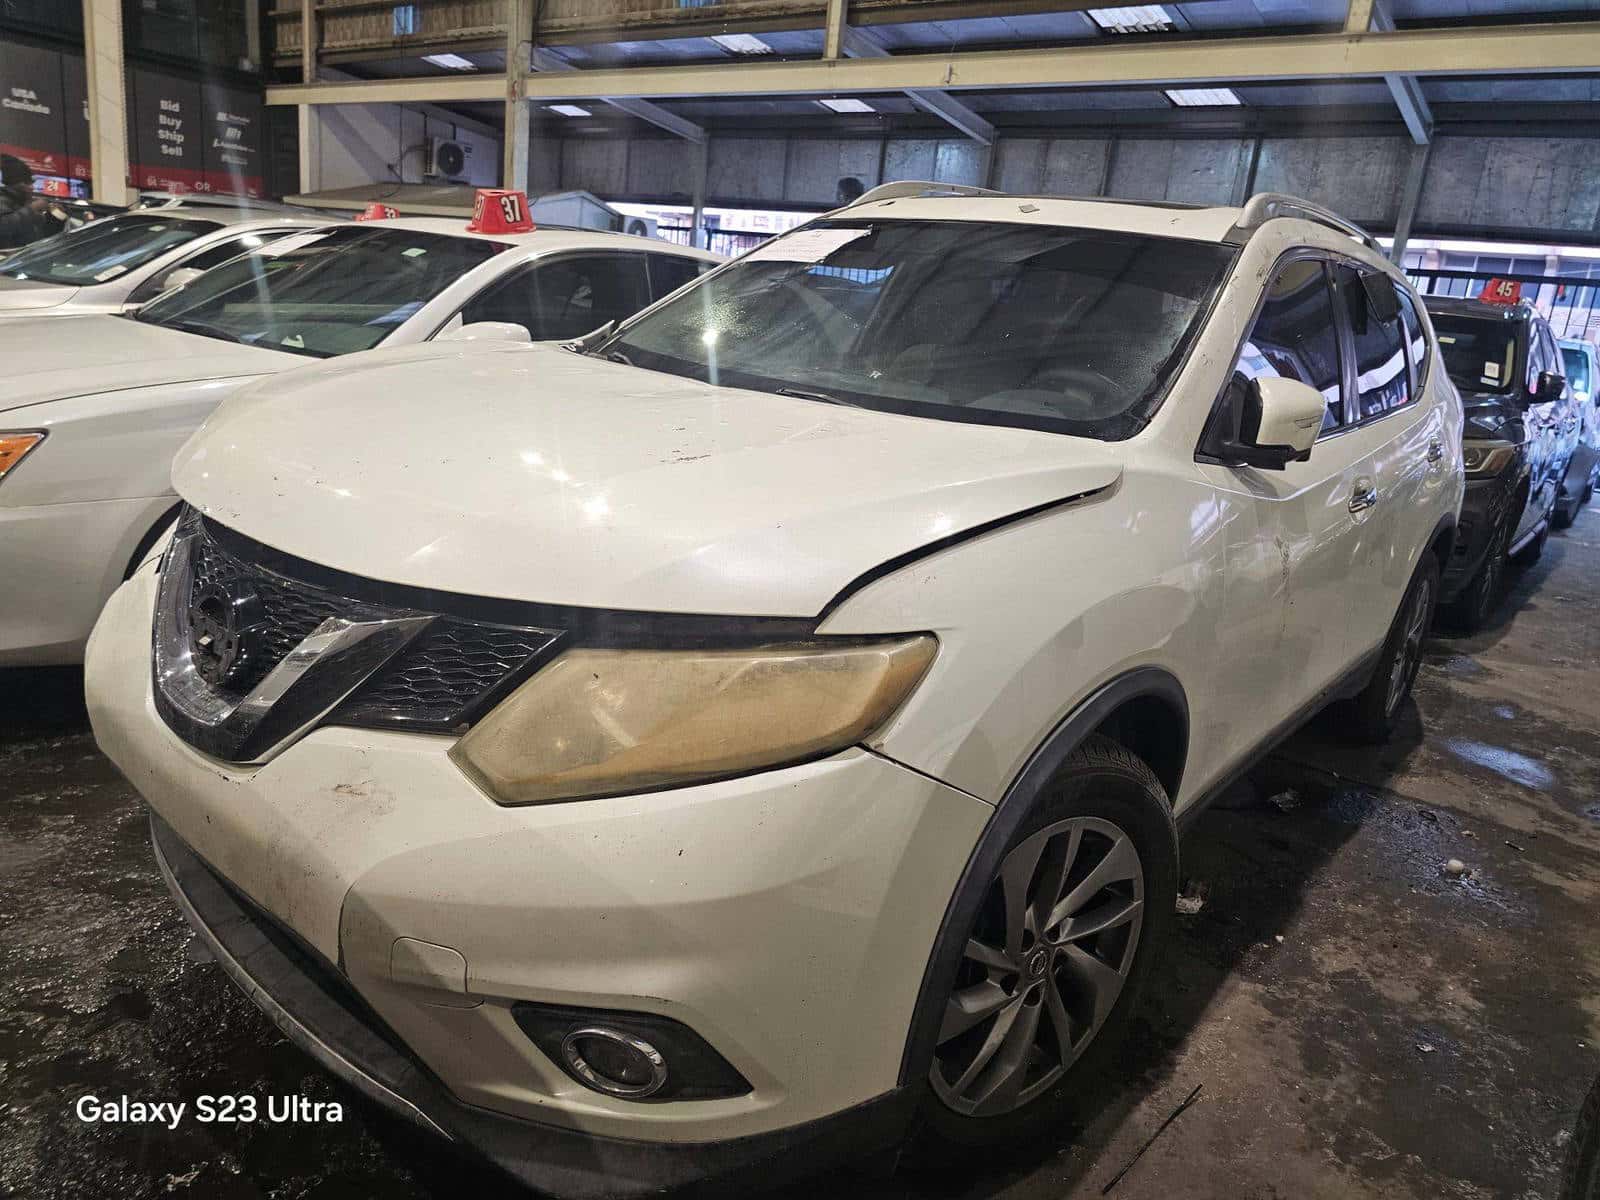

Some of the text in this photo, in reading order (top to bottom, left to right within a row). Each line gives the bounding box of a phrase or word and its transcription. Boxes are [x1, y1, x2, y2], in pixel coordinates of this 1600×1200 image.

[159, 99, 180, 112] Bid
[158, 114, 182, 130] Buy
[158, 129, 184, 143] Ship
[160, 145, 183, 157] Sell
[500, 194, 521, 223] 37
[1496, 281, 1514, 297] 45
